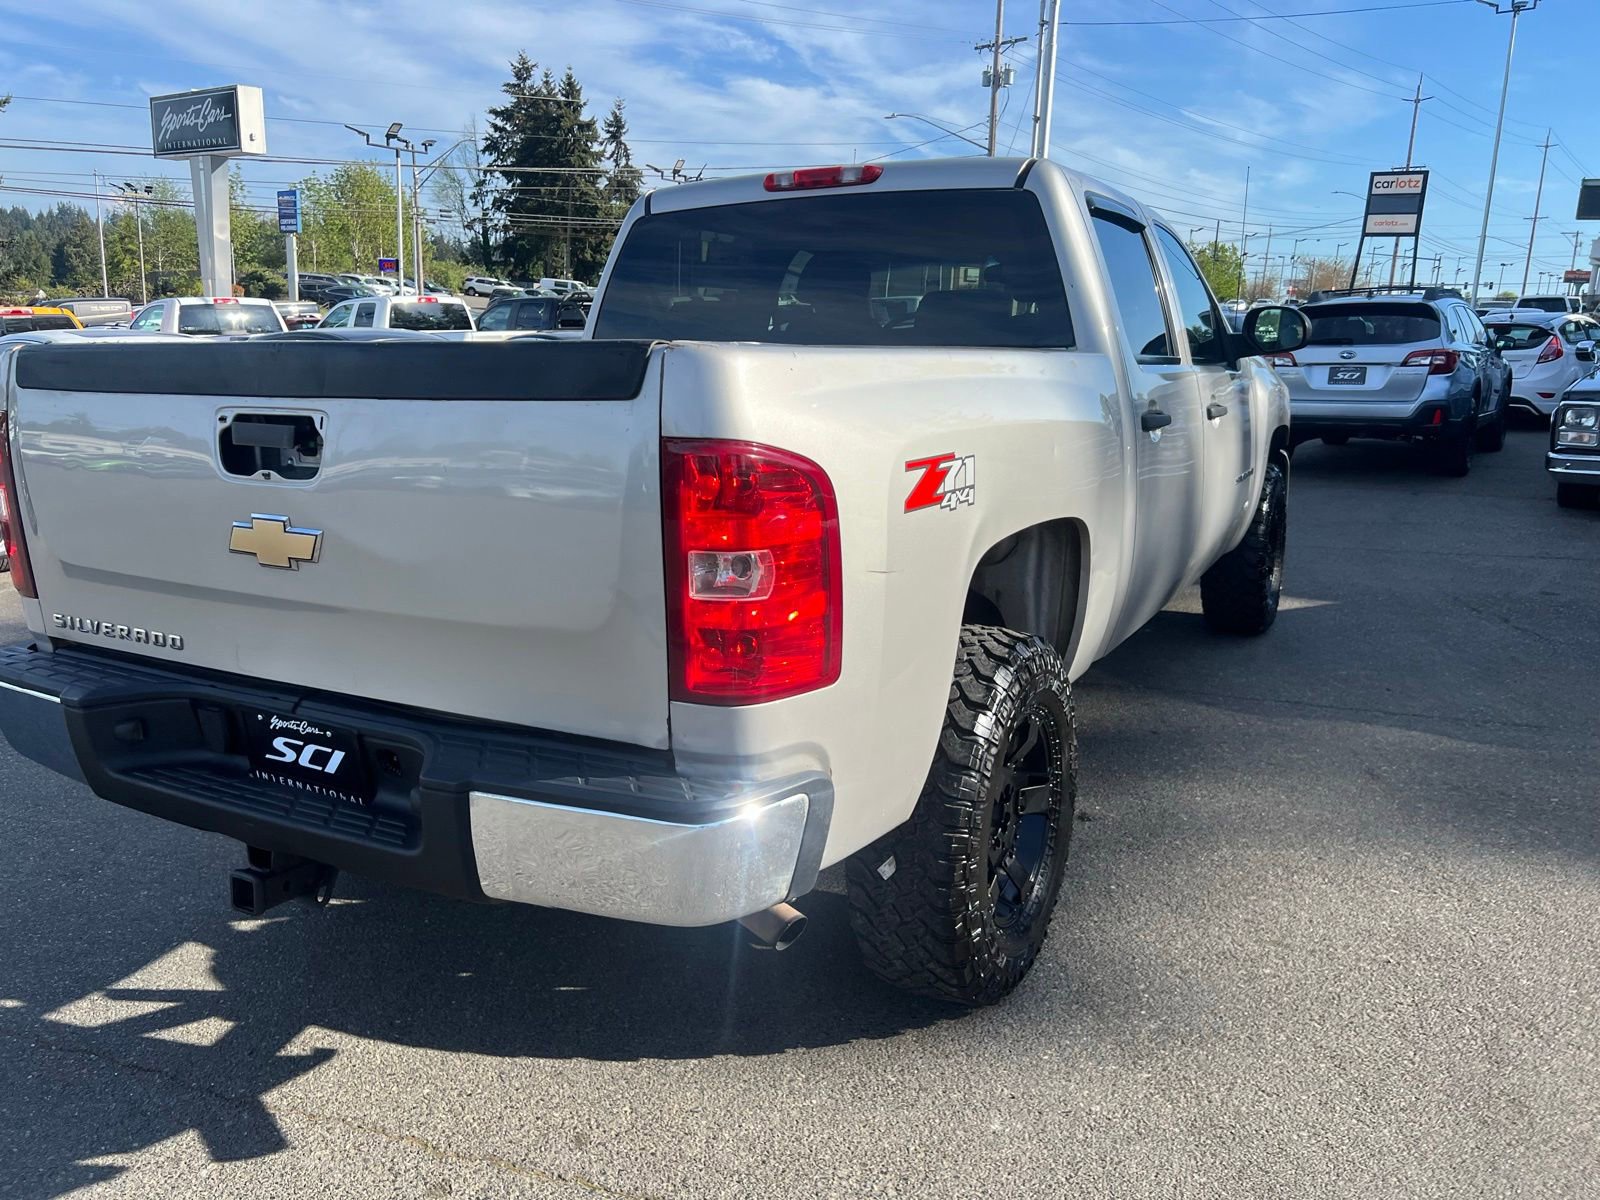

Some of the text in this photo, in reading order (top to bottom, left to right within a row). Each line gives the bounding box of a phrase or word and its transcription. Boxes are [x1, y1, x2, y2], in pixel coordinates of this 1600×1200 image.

[159, 98, 232, 143] Sports Cars
[164, 137, 228, 150] INTERNATIONAL
[1374, 177, 1421, 189] carlotz
[1333, 371, 1361, 380] SCI
[904, 452, 975, 514] Z71
[53, 613, 184, 650] SILVERADO
[270, 715, 324, 735] Sports Cars
[265, 736, 345, 774] SCI
[256, 770, 364, 805] INTERNATIONAL
